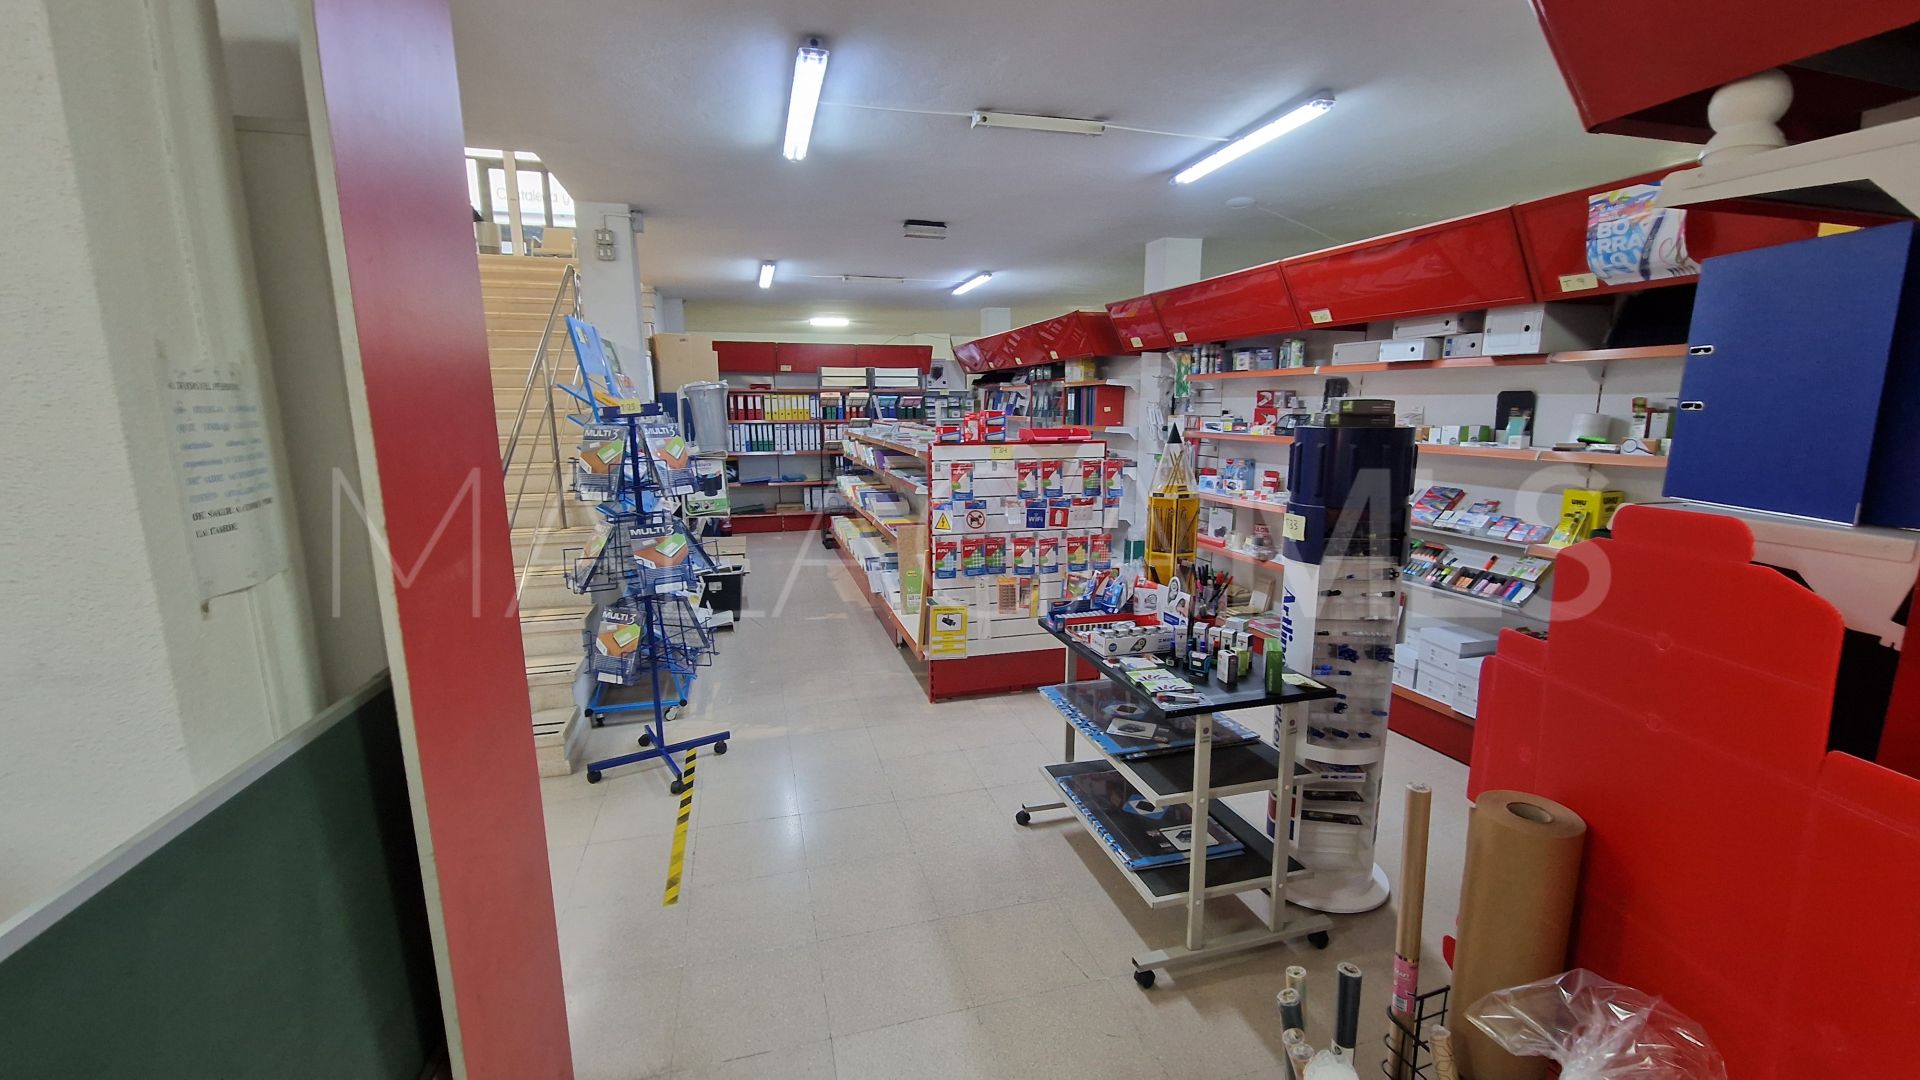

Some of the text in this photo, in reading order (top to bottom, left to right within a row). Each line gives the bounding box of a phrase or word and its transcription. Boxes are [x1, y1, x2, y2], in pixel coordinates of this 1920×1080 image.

[584, 428, 620, 440] MULTI 3
[644, 427, 669, 435] MULTI
[630, 524, 674, 536] MULTI 3
[602, 610, 629, 621] MULTI
